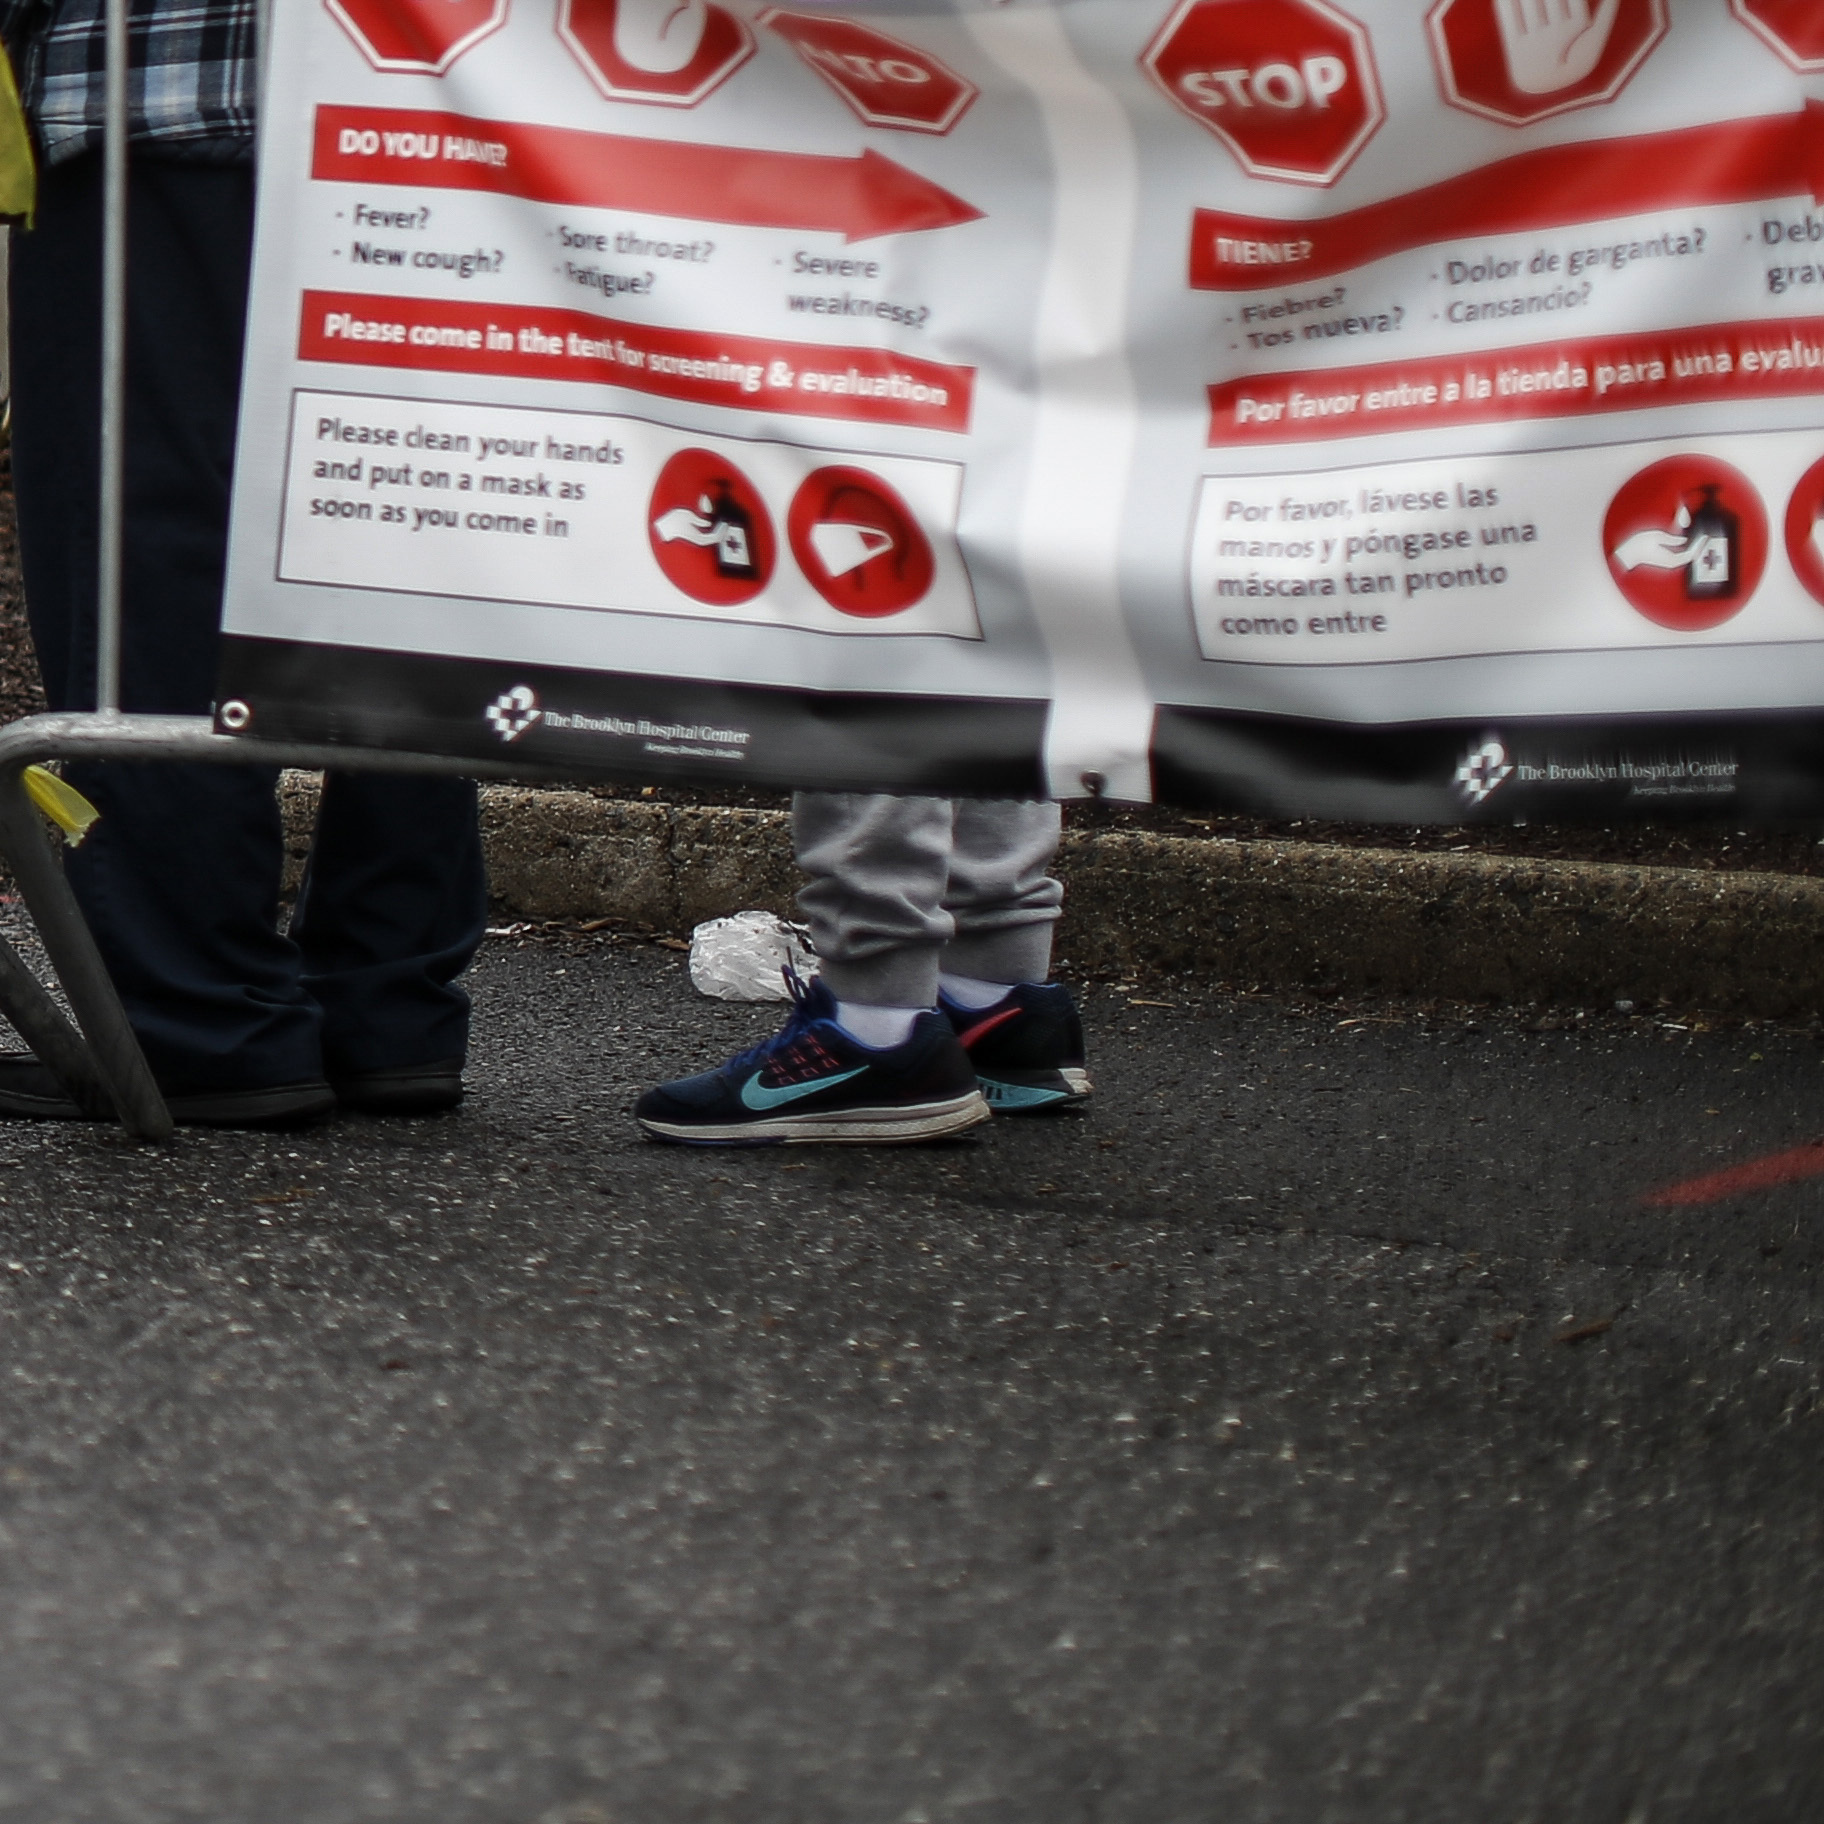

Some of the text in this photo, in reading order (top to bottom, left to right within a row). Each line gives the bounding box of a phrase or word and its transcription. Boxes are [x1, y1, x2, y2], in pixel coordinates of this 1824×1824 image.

[1181, 55, 1348, 110] STOP
[338, 129, 508, 167] DO YOU HAVE?
[355, 203, 431, 229] Fever?
[351, 241, 505, 279] New cough?
[559, 225, 715, 264] Sore throat?
[793, 250, 881, 279] Severe
[1215, 236, 1314, 265] TIENE?
[1447, 227, 1707, 286] Dolor de garganta?
[565, 261, 656, 297] Fatigue?
[786, 290, 931, 331] weakness?
[1241, 286, 1347, 324] Fiebre?
[1447, 281, 1593, 324] Cansancio?
[1247, 305, 1404, 351] Tos nueva?
[324, 313, 949, 406] Please come in the tent for screening & evaluation
[1238, 351, 1734, 424] Por favor entre a la tienda para una
[317, 416, 625, 465] Please clean your hands
[313, 458, 586, 501] and put on a mask as
[310, 496, 570, 538] soon as you come in
[1224, 481, 1498, 522] Por favor, lávese las
[1219, 523, 1537, 564] manos y póngase una
[1217, 562, 1507, 598] máscara tan pronto
[1220, 610, 1388, 636] como entre
[544, 711, 750, 744] The Brooklyn Hospital Center
[1518, 761, 1739, 782] The Brooklyn Hospital Center
